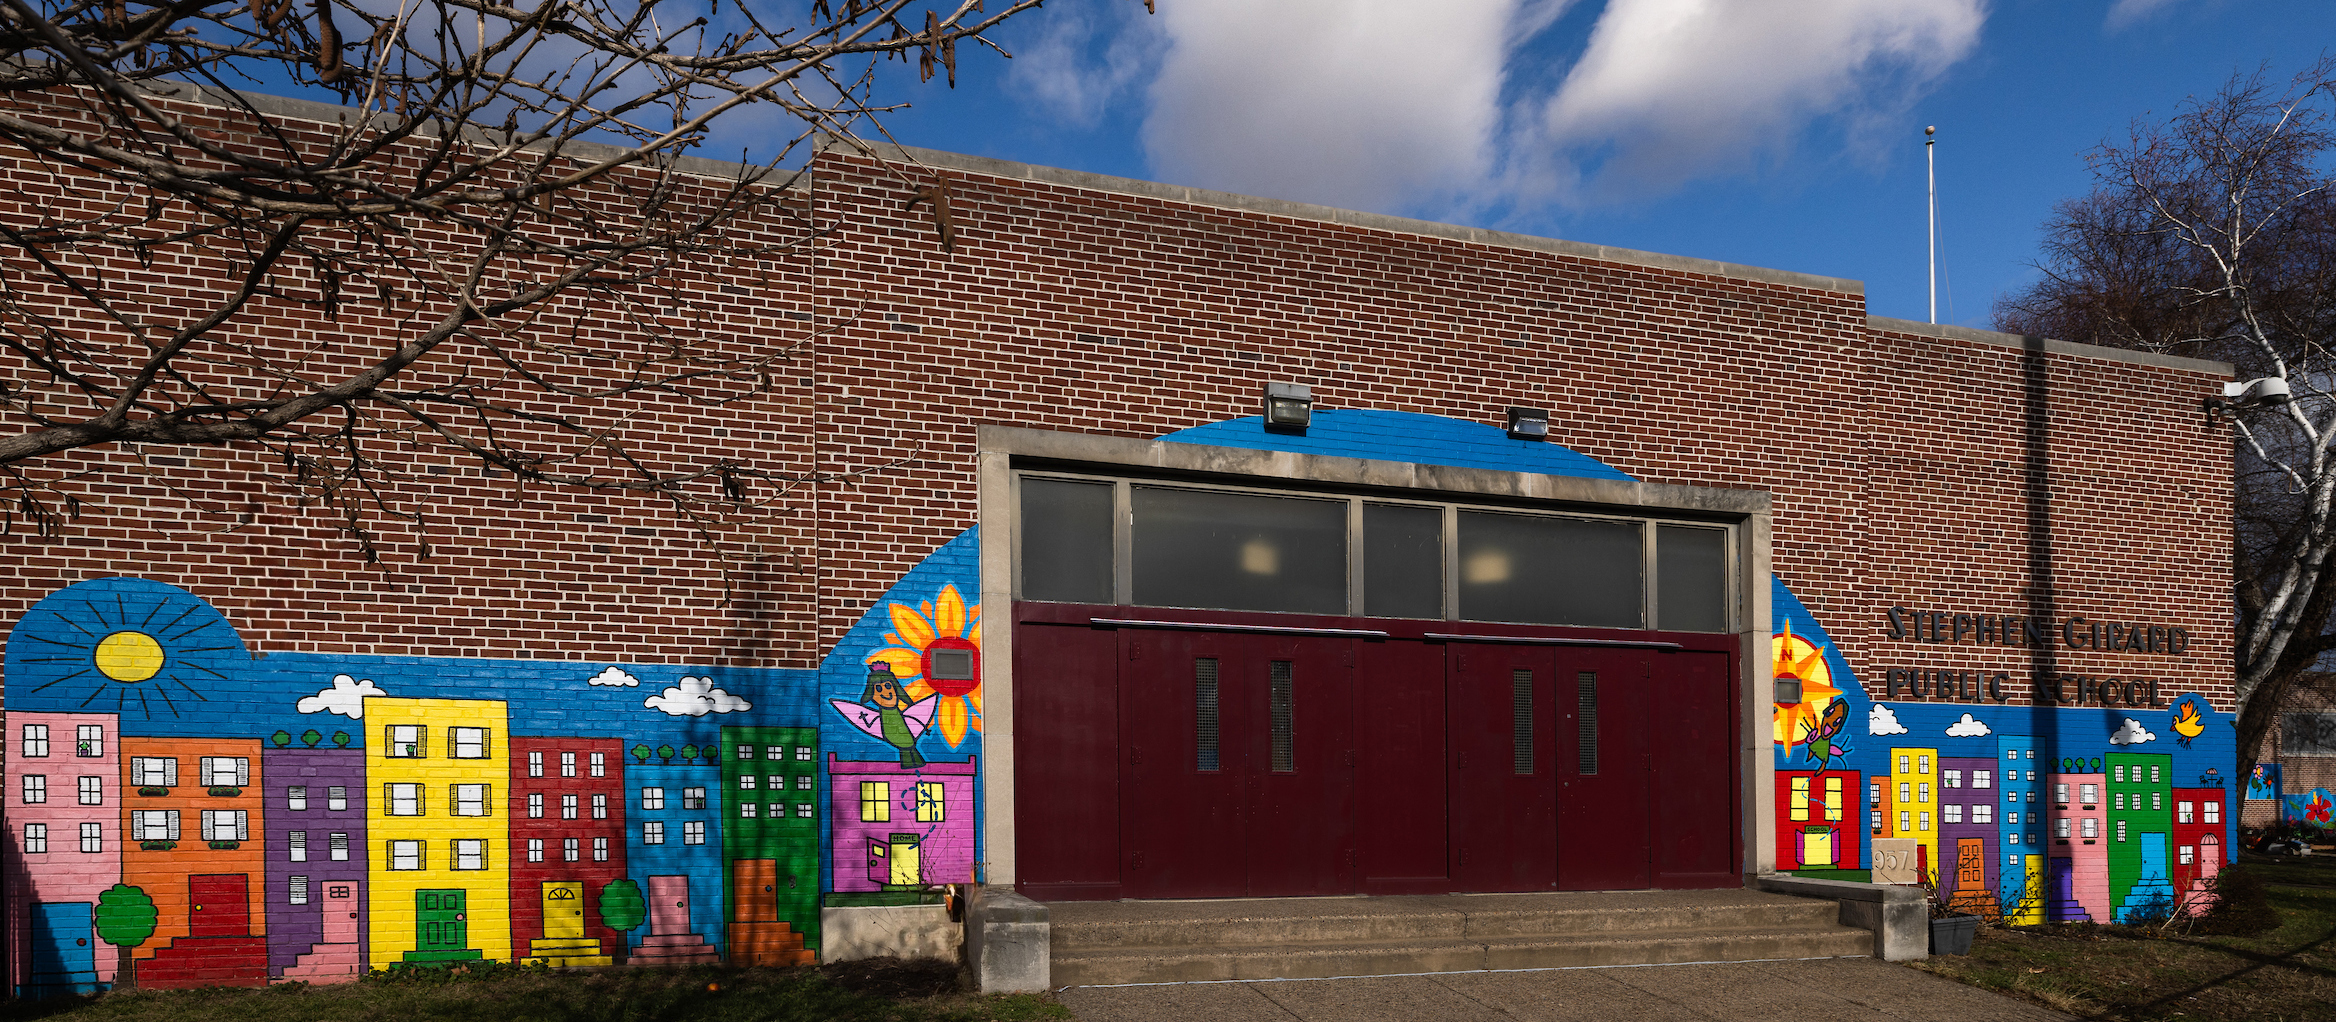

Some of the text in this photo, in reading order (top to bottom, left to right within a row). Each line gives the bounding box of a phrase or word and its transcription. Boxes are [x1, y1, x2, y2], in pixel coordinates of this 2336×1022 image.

[1886, 606, 2189, 654] STEPHEN GIRARD
[1782, 649, 1792, 661] N
[1886, 669, 2165, 706] PUBLIC SCHOOL
